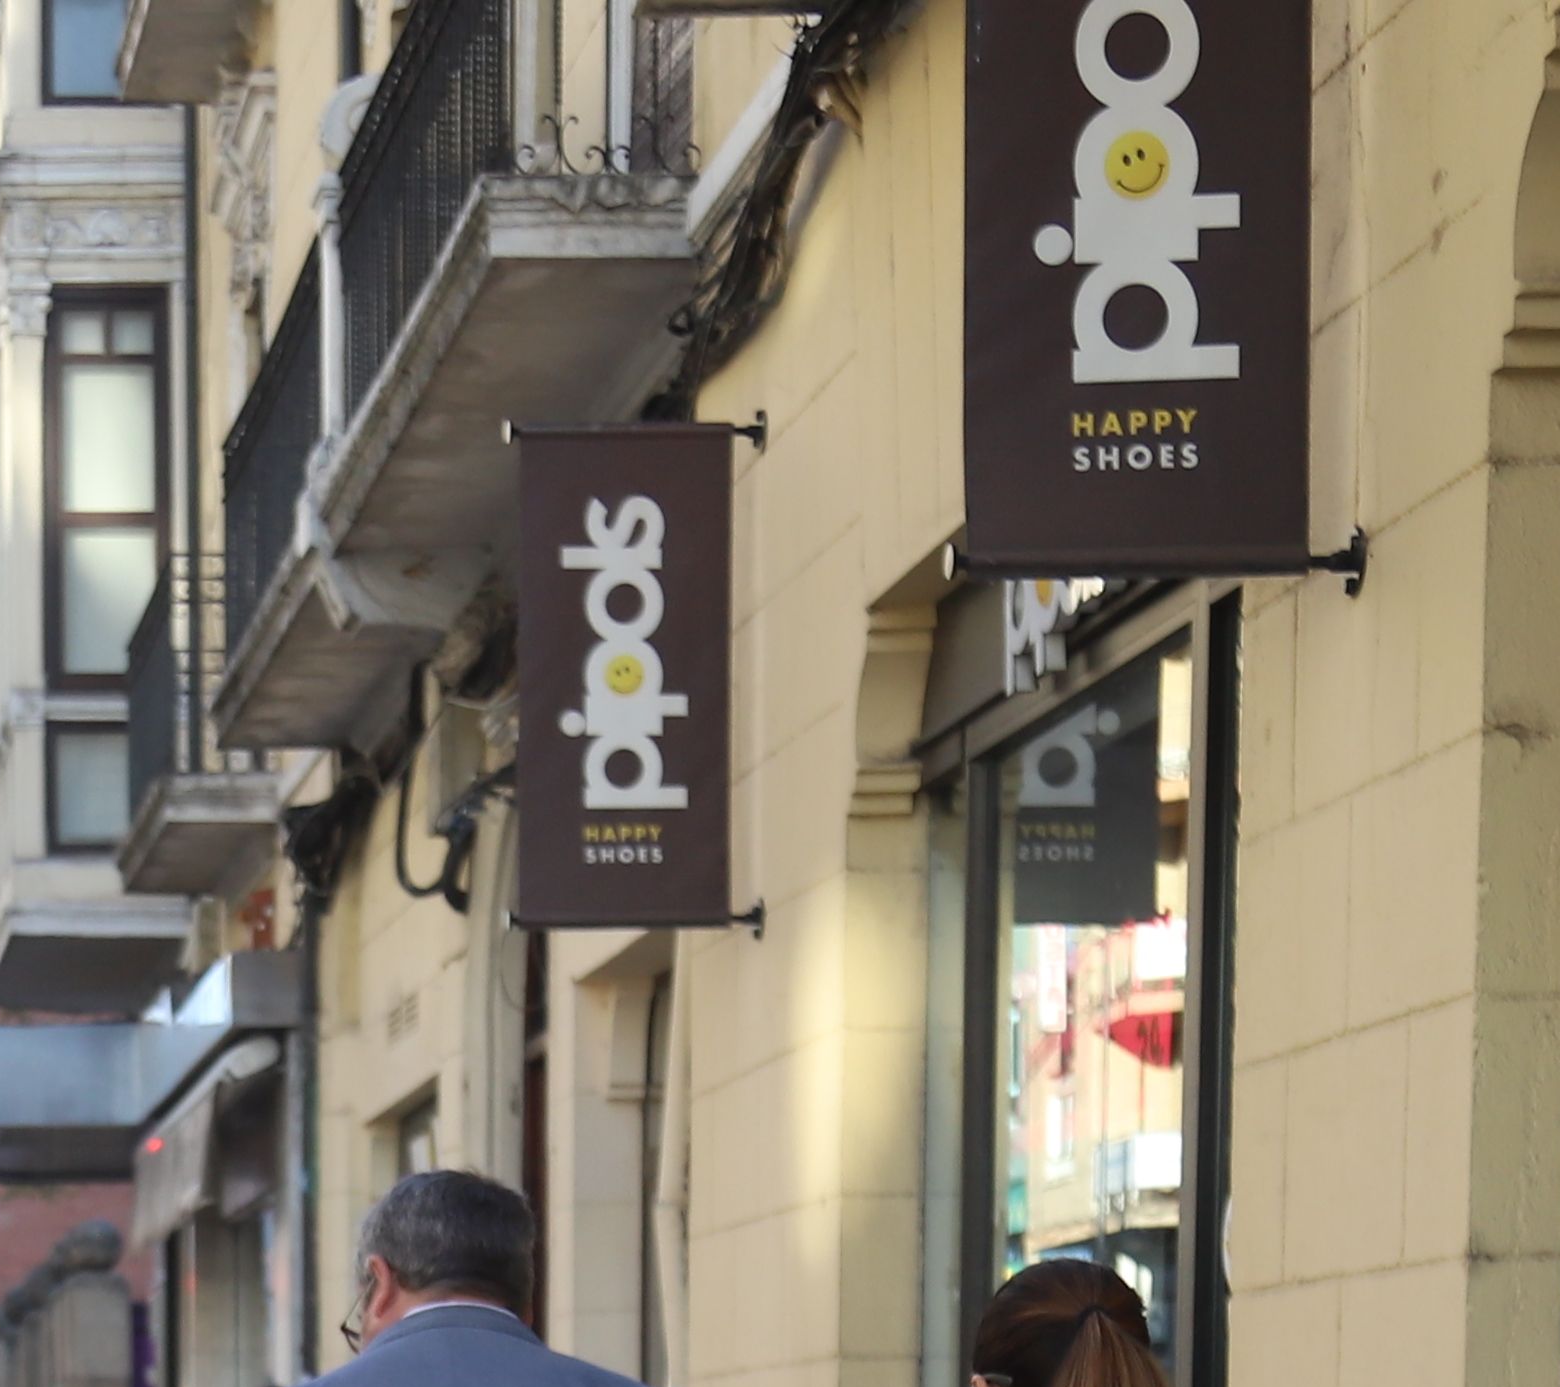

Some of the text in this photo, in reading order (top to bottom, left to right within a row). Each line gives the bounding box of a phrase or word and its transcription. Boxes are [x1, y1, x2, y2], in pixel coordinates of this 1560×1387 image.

[1071, 408, 1198, 438] HAPPY
[1073, 442, 1200, 472] SHOES
[559, 495, 688, 809] pipols
[583, 824, 664, 843] HAPPY
[583, 845, 665, 865] SHOES
